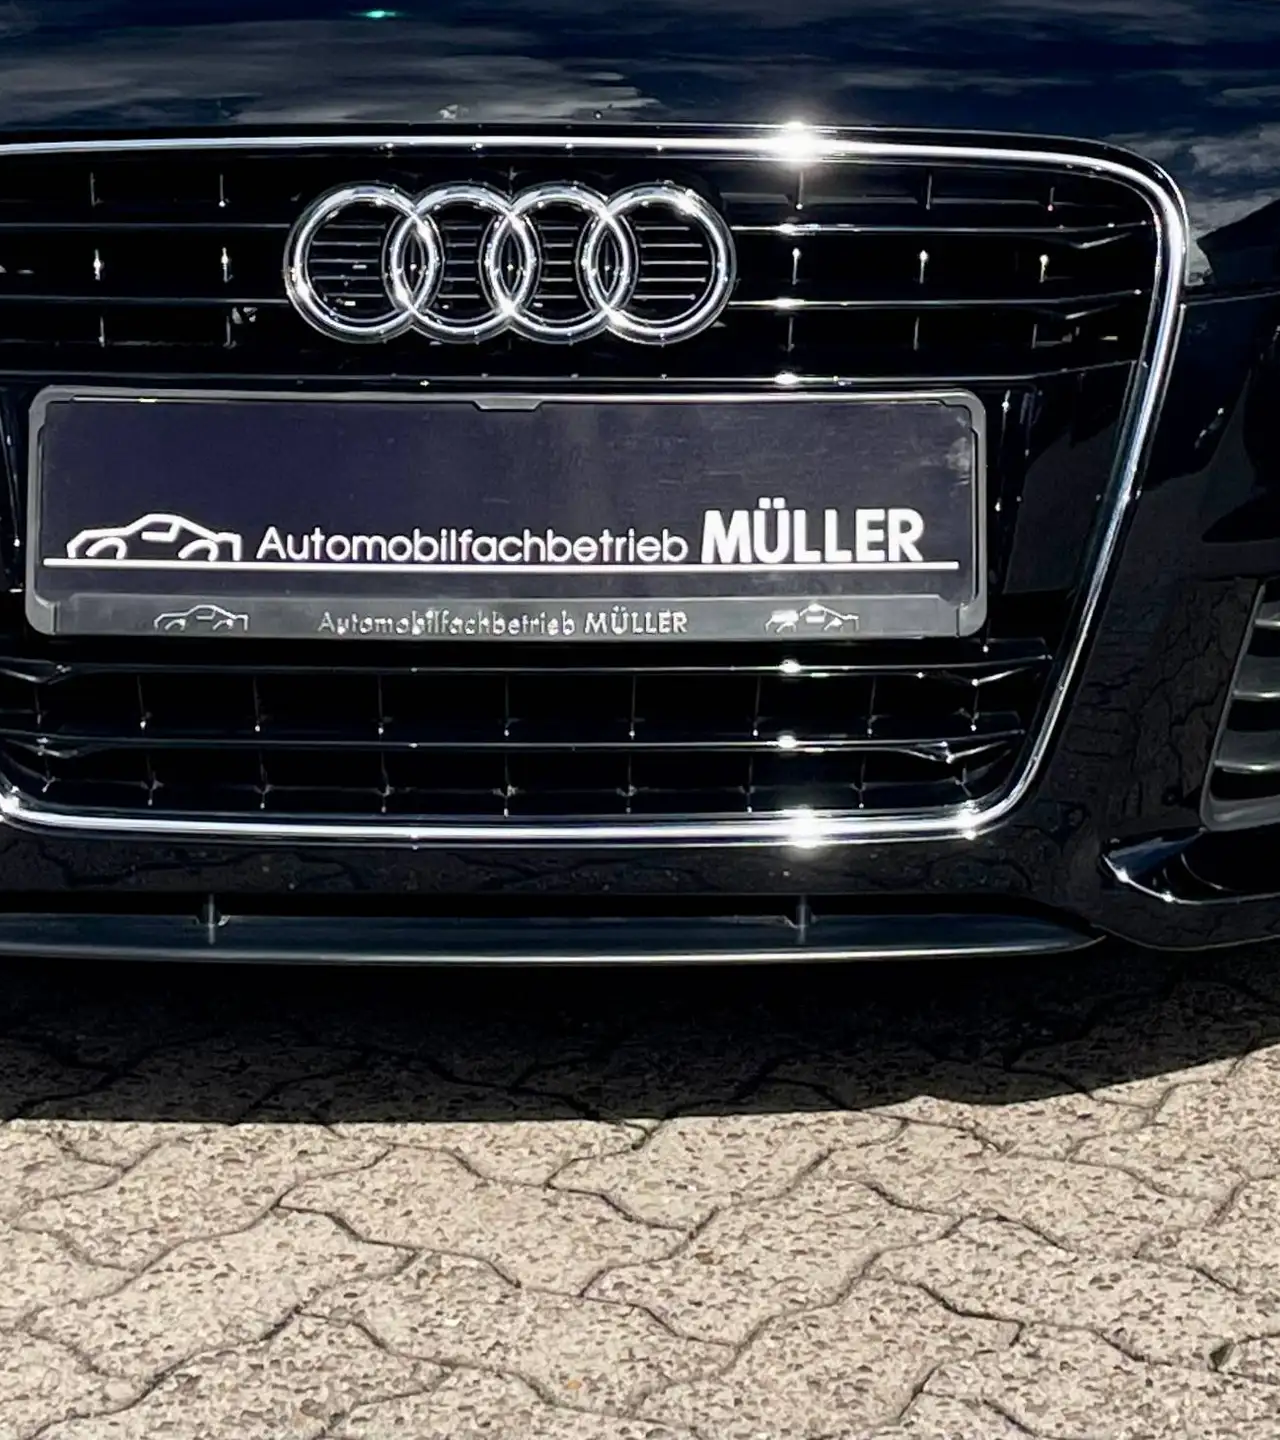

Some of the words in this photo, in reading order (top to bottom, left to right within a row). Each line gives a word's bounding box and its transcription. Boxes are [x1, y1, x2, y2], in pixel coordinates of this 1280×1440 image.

[256, 525, 689, 563] Automobilfachbetrieb
[700, 497, 925, 563] MÜLLER
[319, 608, 576, 638] Automobilfachbetrieb
[585, 608, 688, 637] MÜLLER
